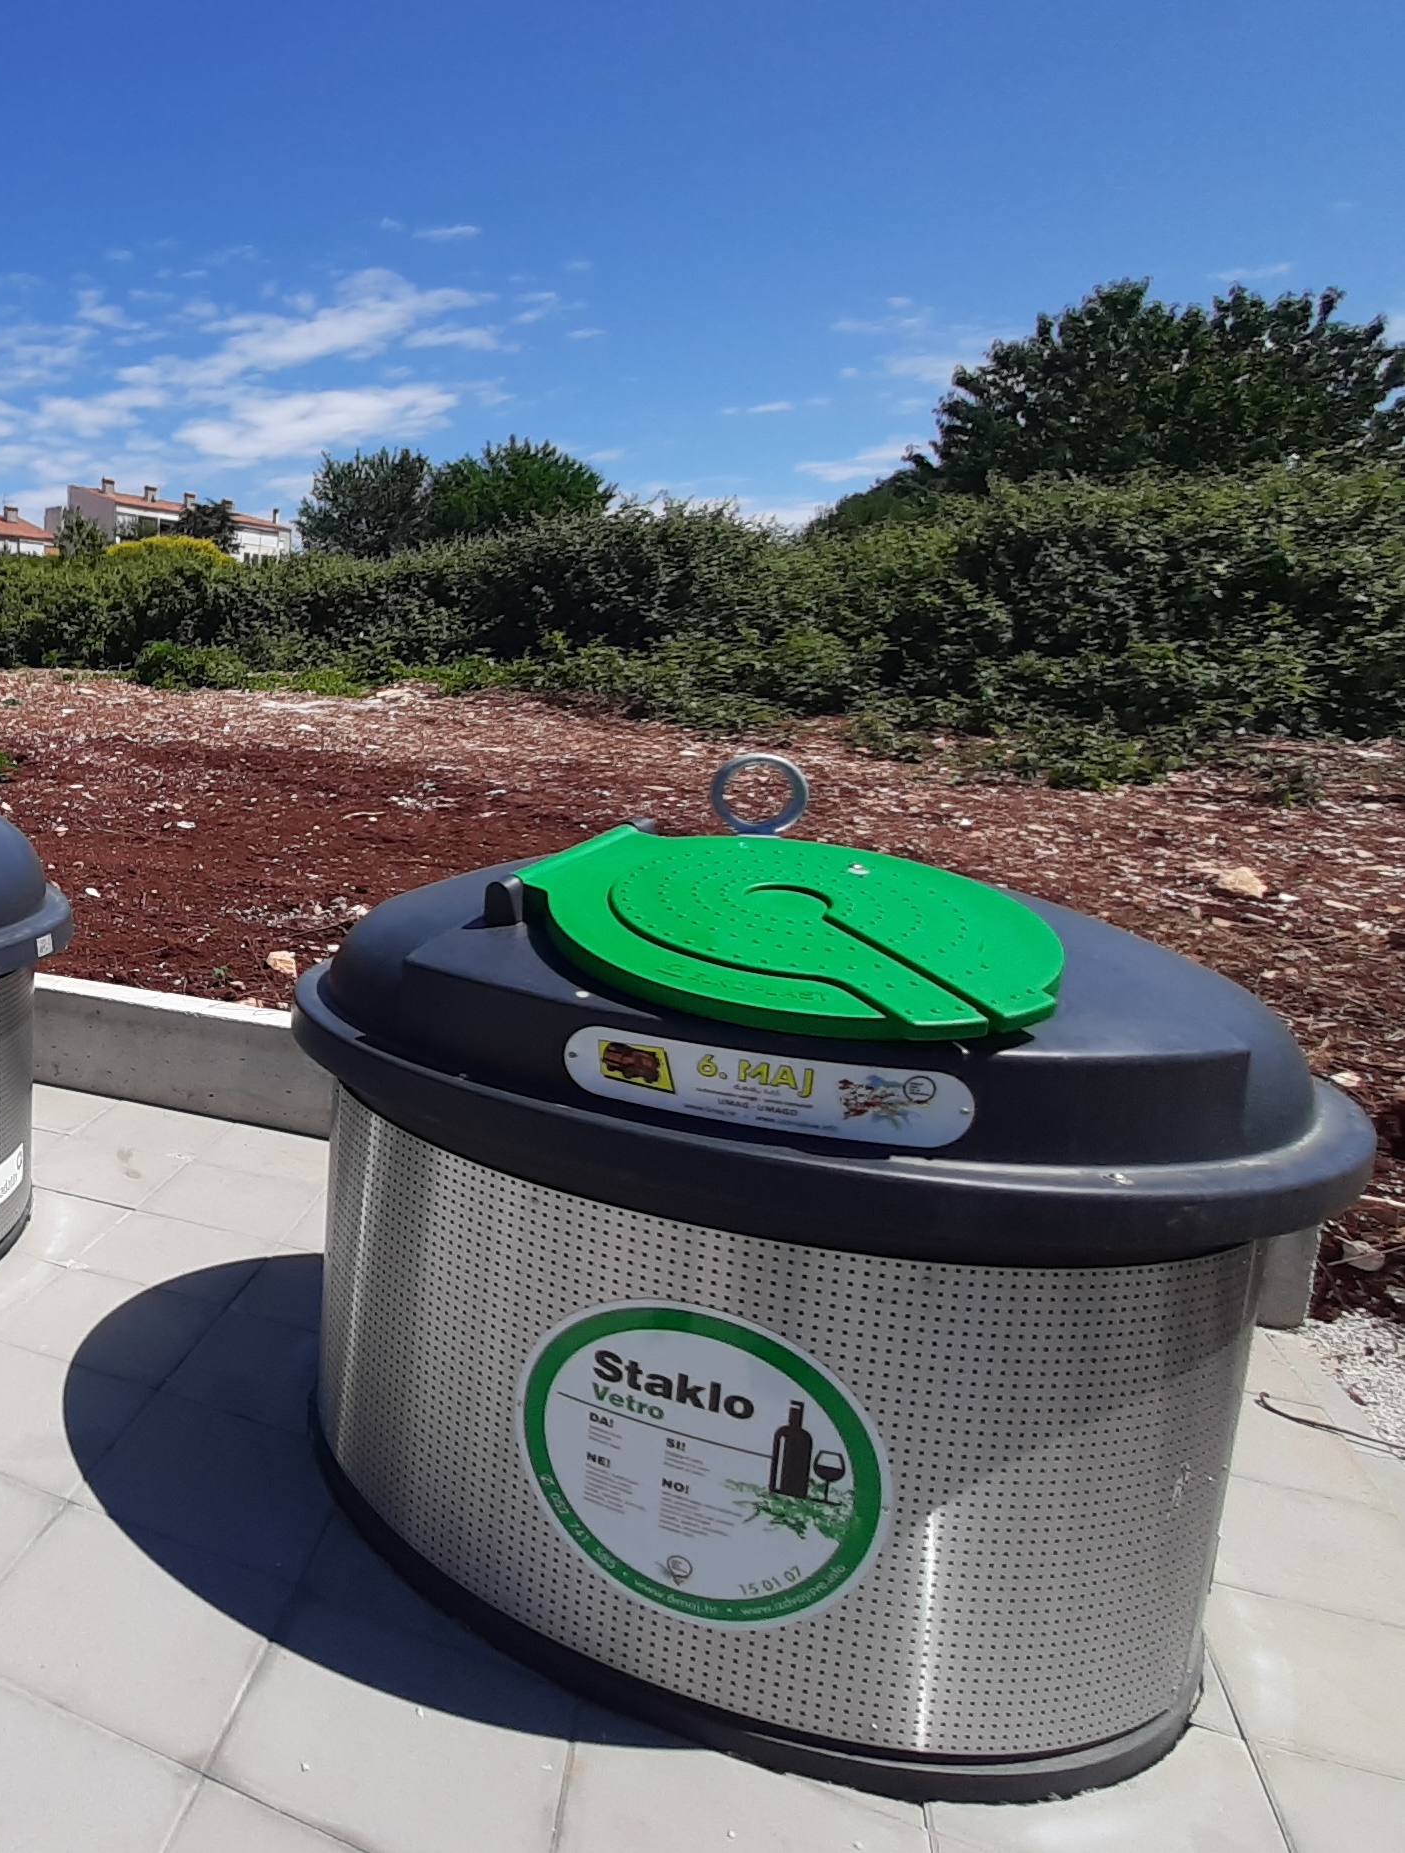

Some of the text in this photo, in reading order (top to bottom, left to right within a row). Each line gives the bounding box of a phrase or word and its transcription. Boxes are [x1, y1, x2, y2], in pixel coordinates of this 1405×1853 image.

[696, 1053, 728, 1080] 6.
[737, 1058, 815, 1098] MAJ
[593, 1350, 754, 1420] Staklo
[592, 1381, 665, 1421] Vetro
[589, 1411, 614, 1429] DA!
[666, 1437, 686, 1453] SI!
[586, 1450, 611, 1469] NE!
[662, 1477, 690, 1496] NO!
[738, 1565, 802, 1596] 15 01 07
